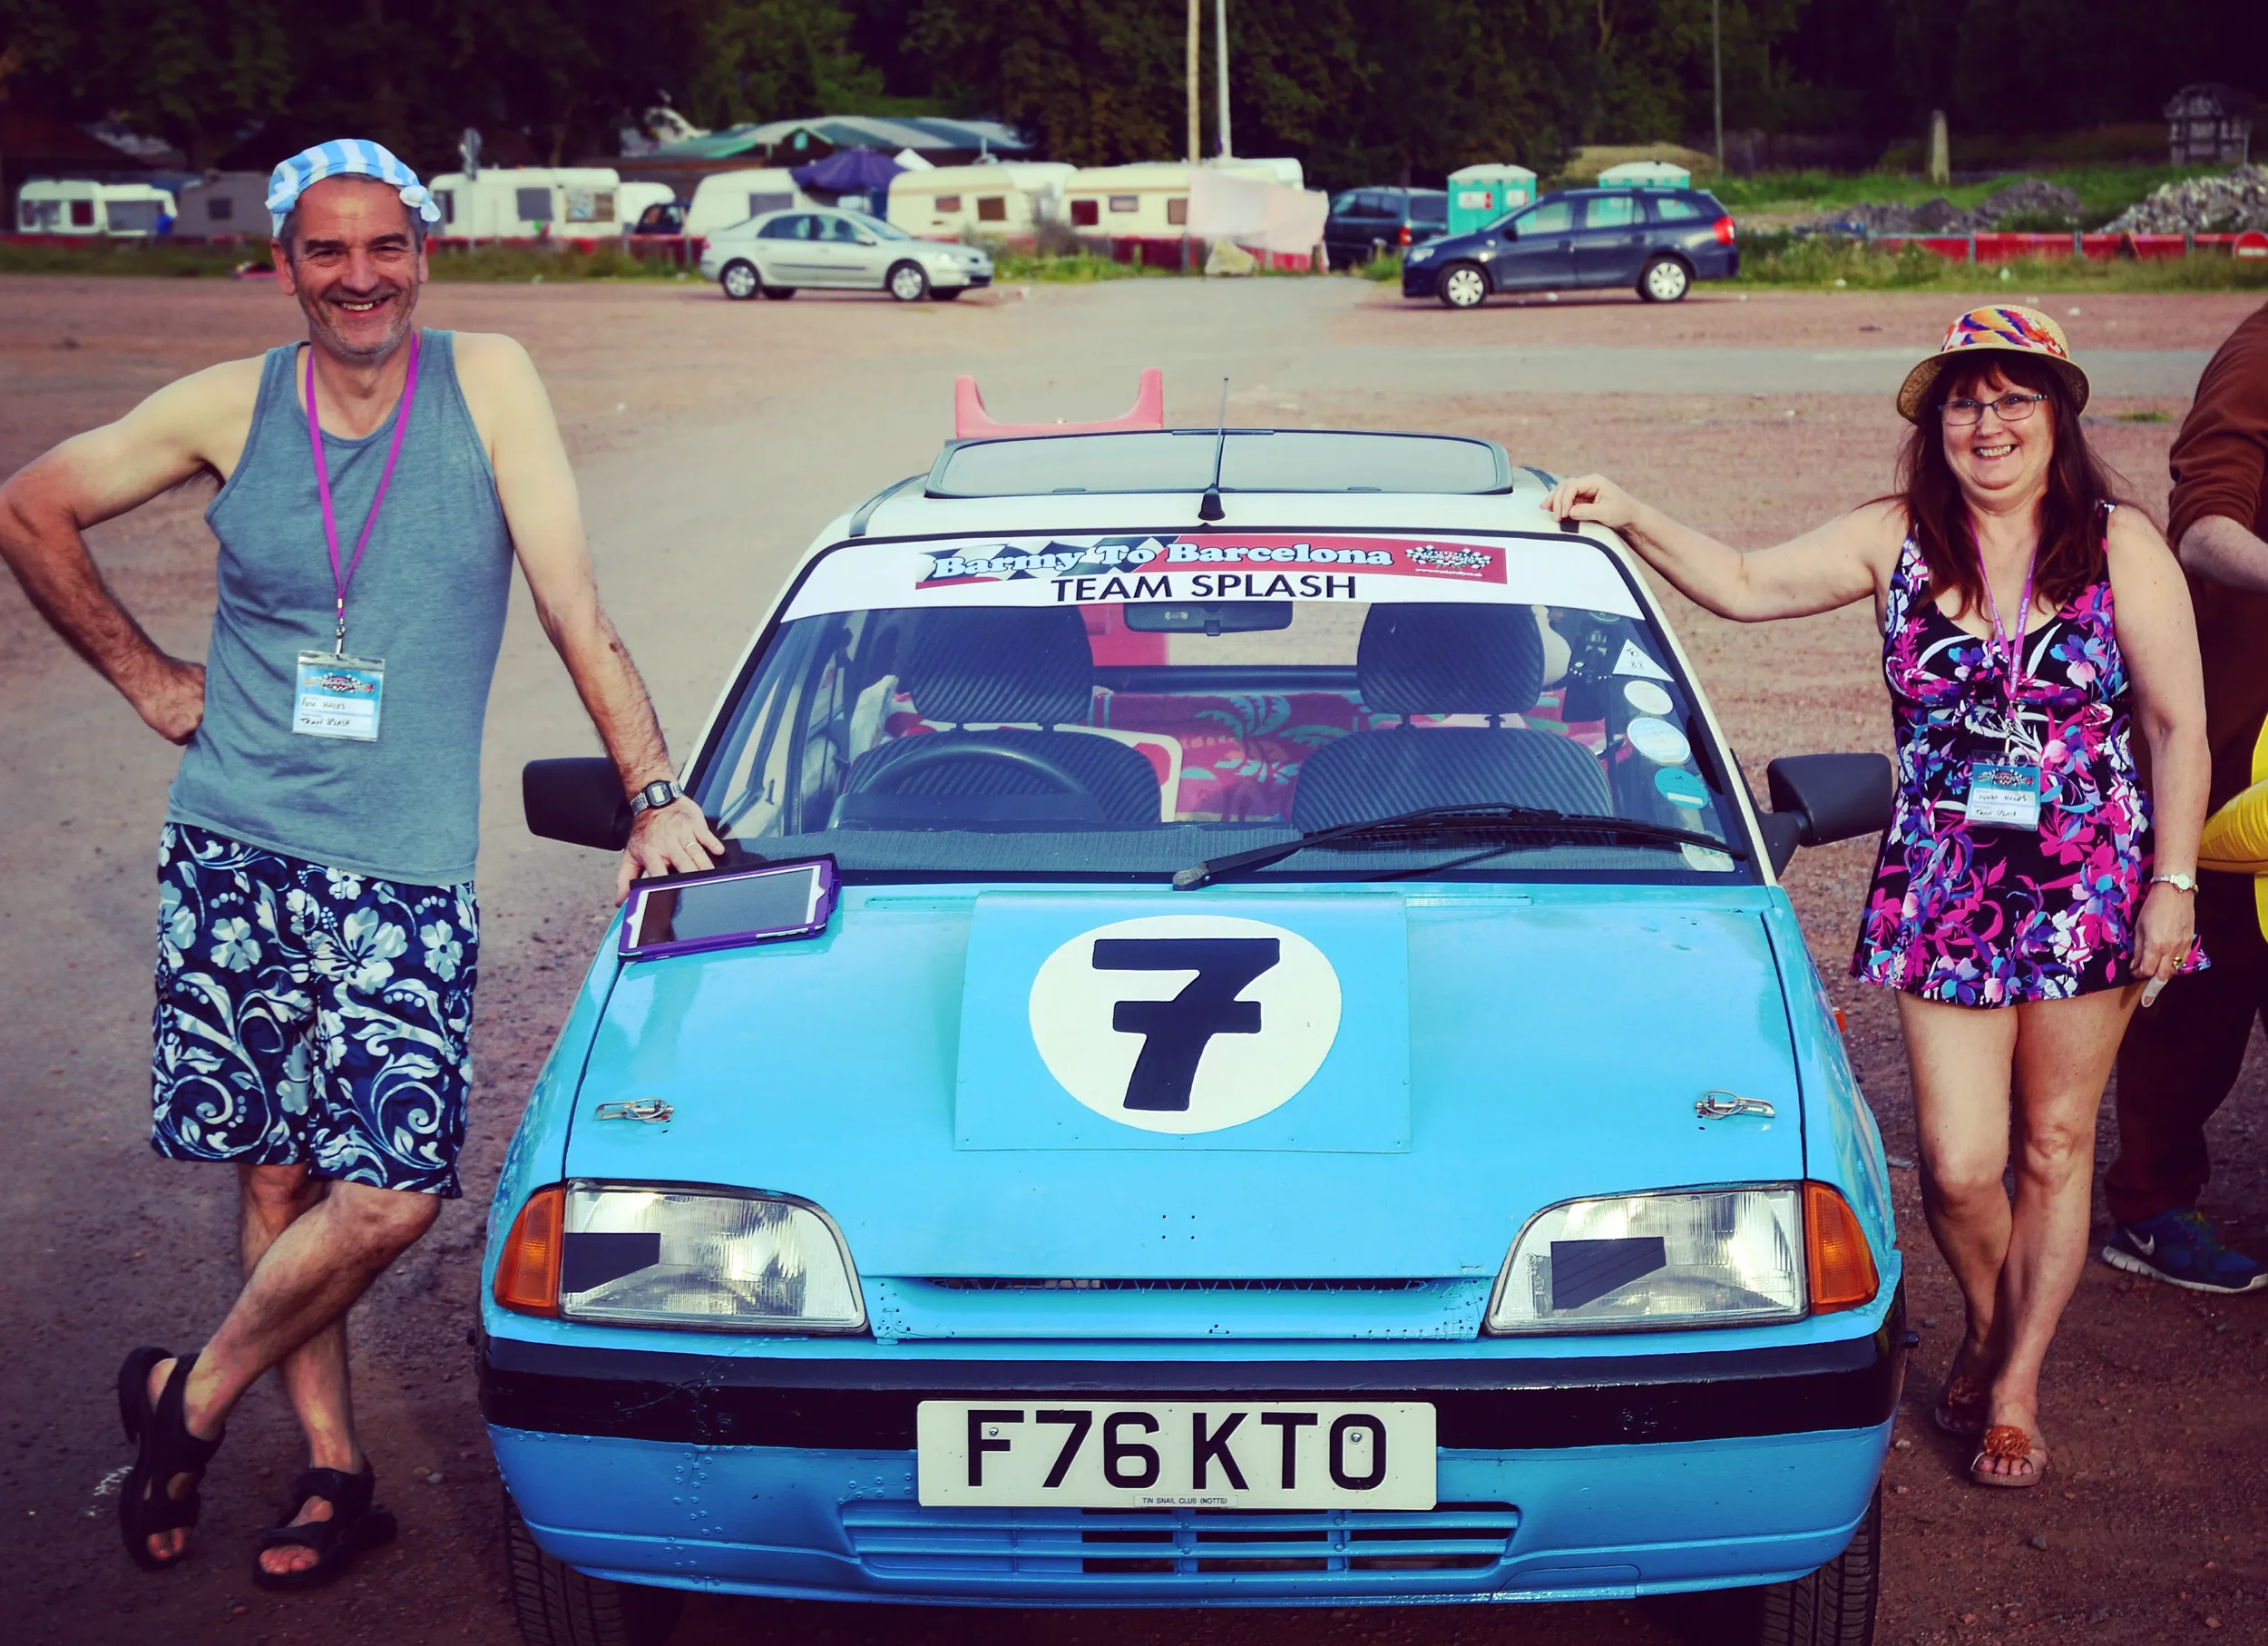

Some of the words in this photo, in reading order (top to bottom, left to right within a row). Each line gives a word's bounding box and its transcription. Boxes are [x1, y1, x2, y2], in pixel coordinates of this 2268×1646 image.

[933, 551, 1087, 578] Barmy
[1095, 544, 1157, 565] To
[1166, 543, 1394, 566] Barcelona
[1051, 575, 1173, 602] TEAM
[1191, 574, 1357, 599] SPLASH
[1092, 938, 1280, 1112] 7
[967, 1409, 1160, 1489] F76
[1192, 1412, 1387, 1491] KTO
